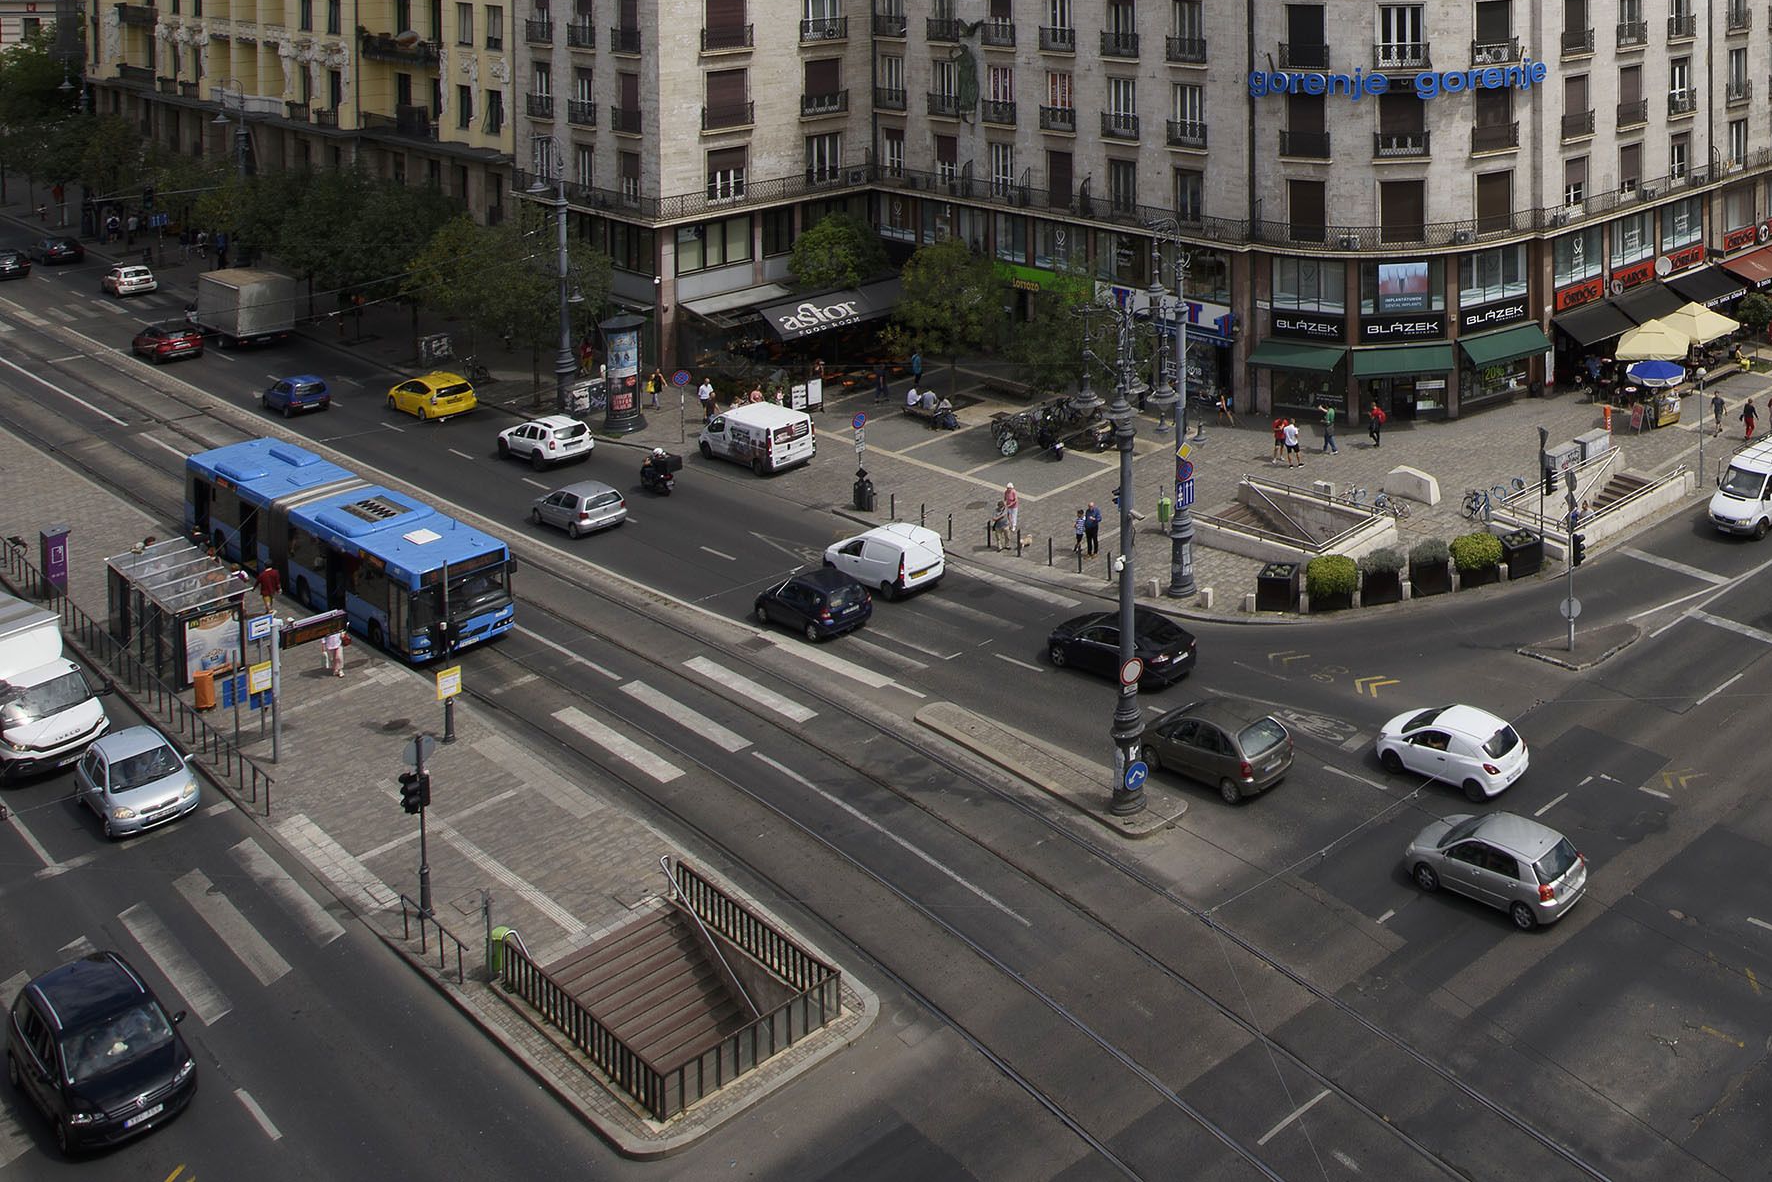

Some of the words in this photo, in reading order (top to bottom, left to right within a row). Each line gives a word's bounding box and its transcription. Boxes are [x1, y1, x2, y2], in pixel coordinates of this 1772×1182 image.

[1250, 67, 1389, 101] gorenje
[1415, 57, 1548, 99] gorenje
[778, 301, 858, 330] astor
[1466, 305, 1524, 325] BLÁZEK
[799, 324, 828, 336] FOOD
[831, 316, 861, 328] ROOM
[1276, 320, 1338, 333] BLÁZEK
[1367, 321, 1439, 334] BLÁZEK
[55, 728, 81, 741] IVECO
